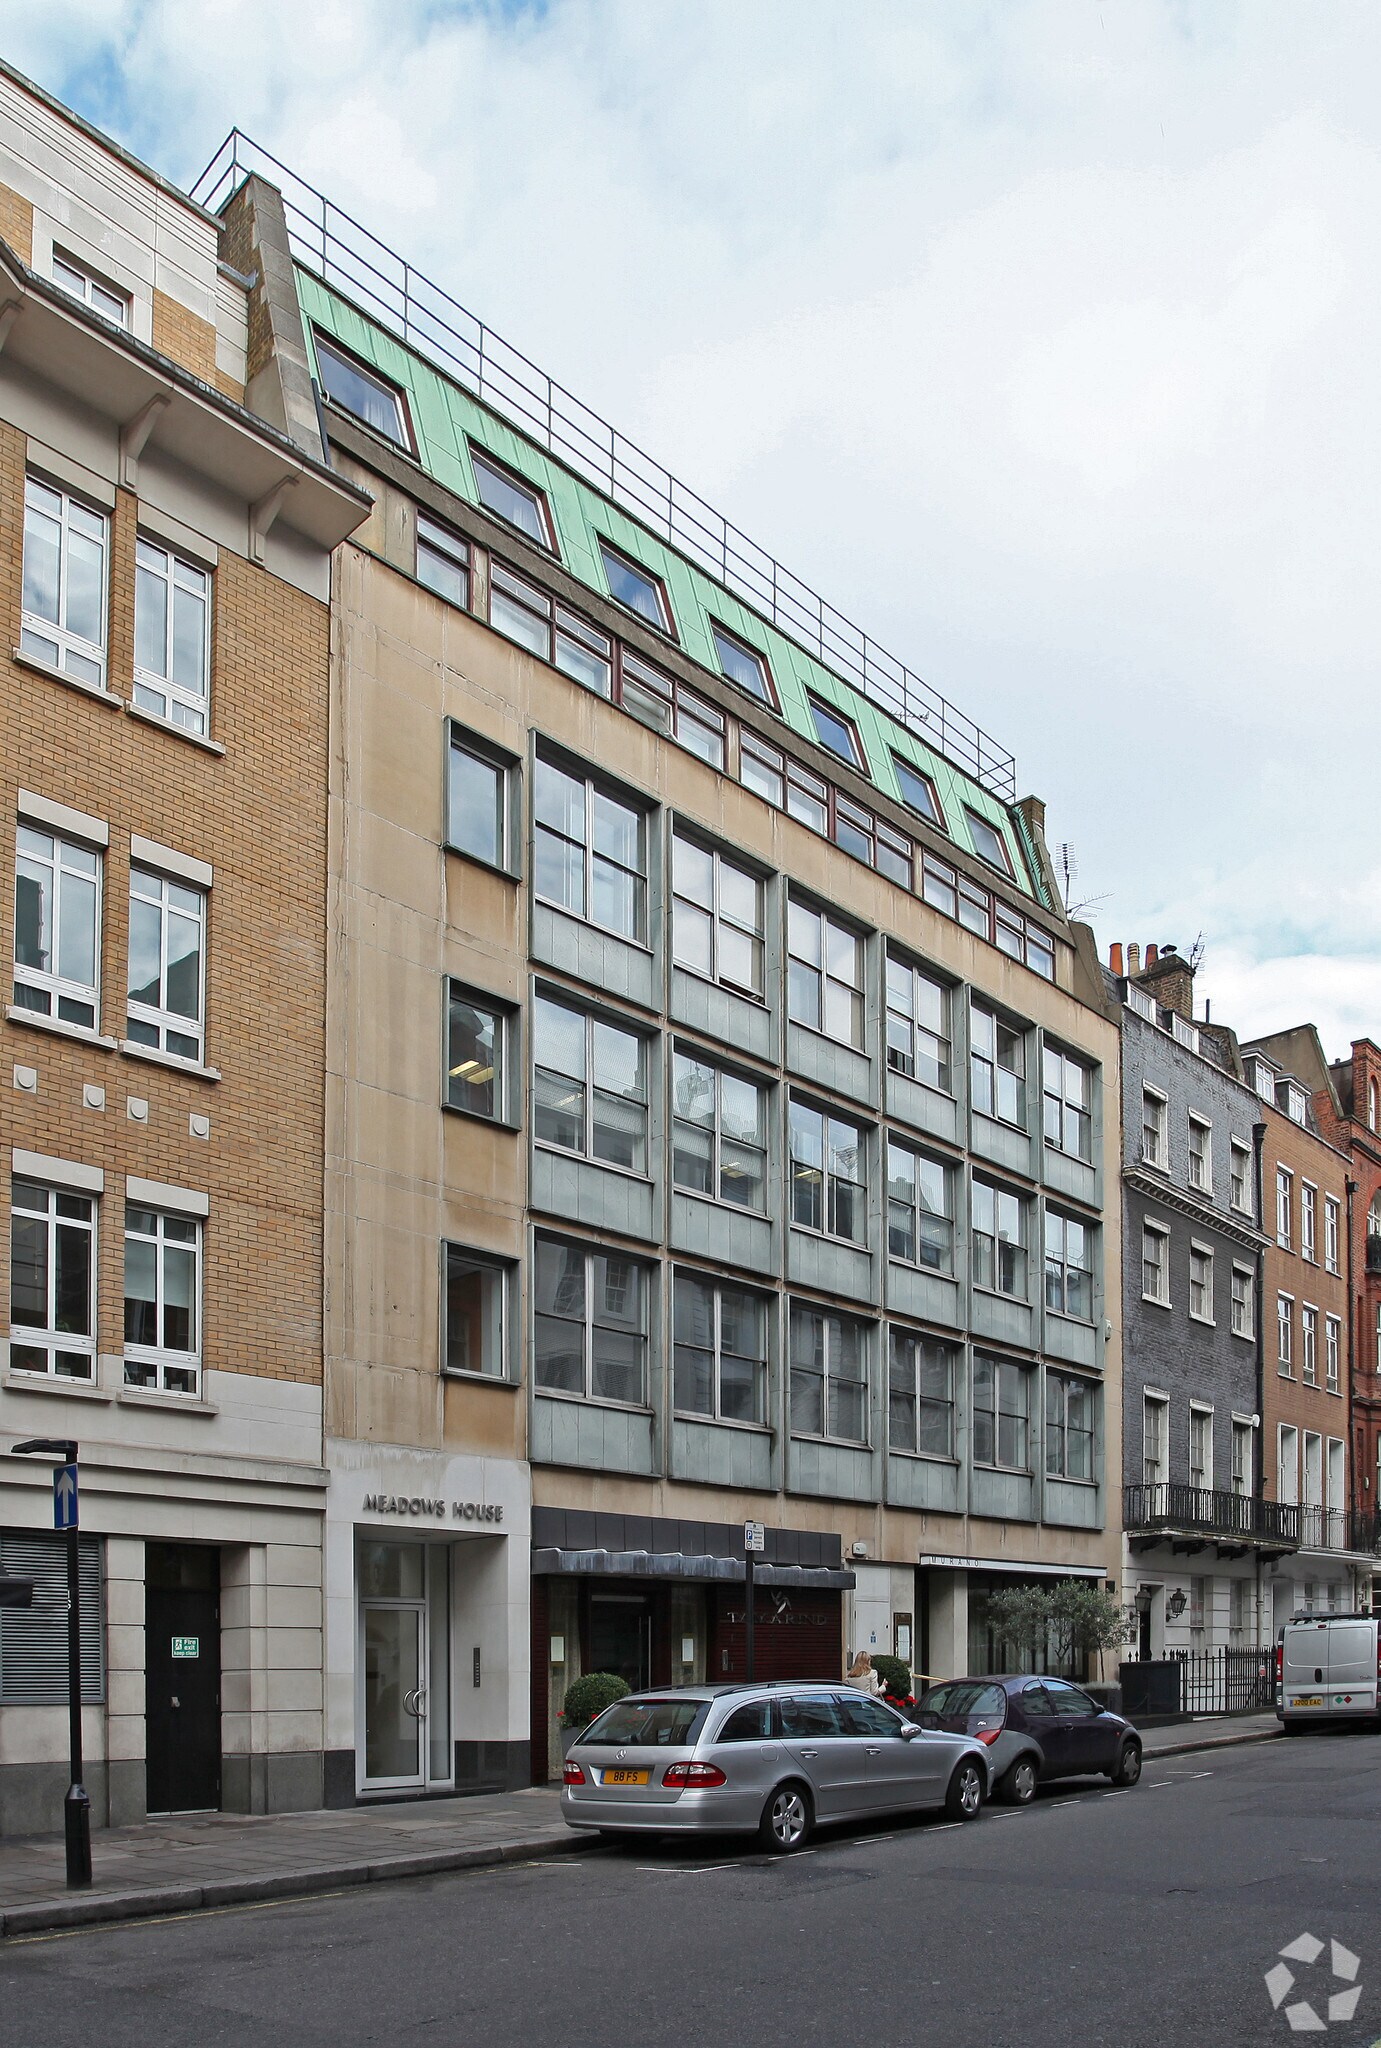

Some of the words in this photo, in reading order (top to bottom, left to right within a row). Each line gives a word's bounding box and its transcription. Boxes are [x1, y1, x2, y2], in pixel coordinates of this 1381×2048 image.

[362, 1493, 446, 1518] MEADOWS
[452, 1501, 504, 1523] HOUSE
[931, 1555, 979, 1567] MURANO
[613, 1771, 625, 1782] 88
[626, 1771, 639, 1782] FS
